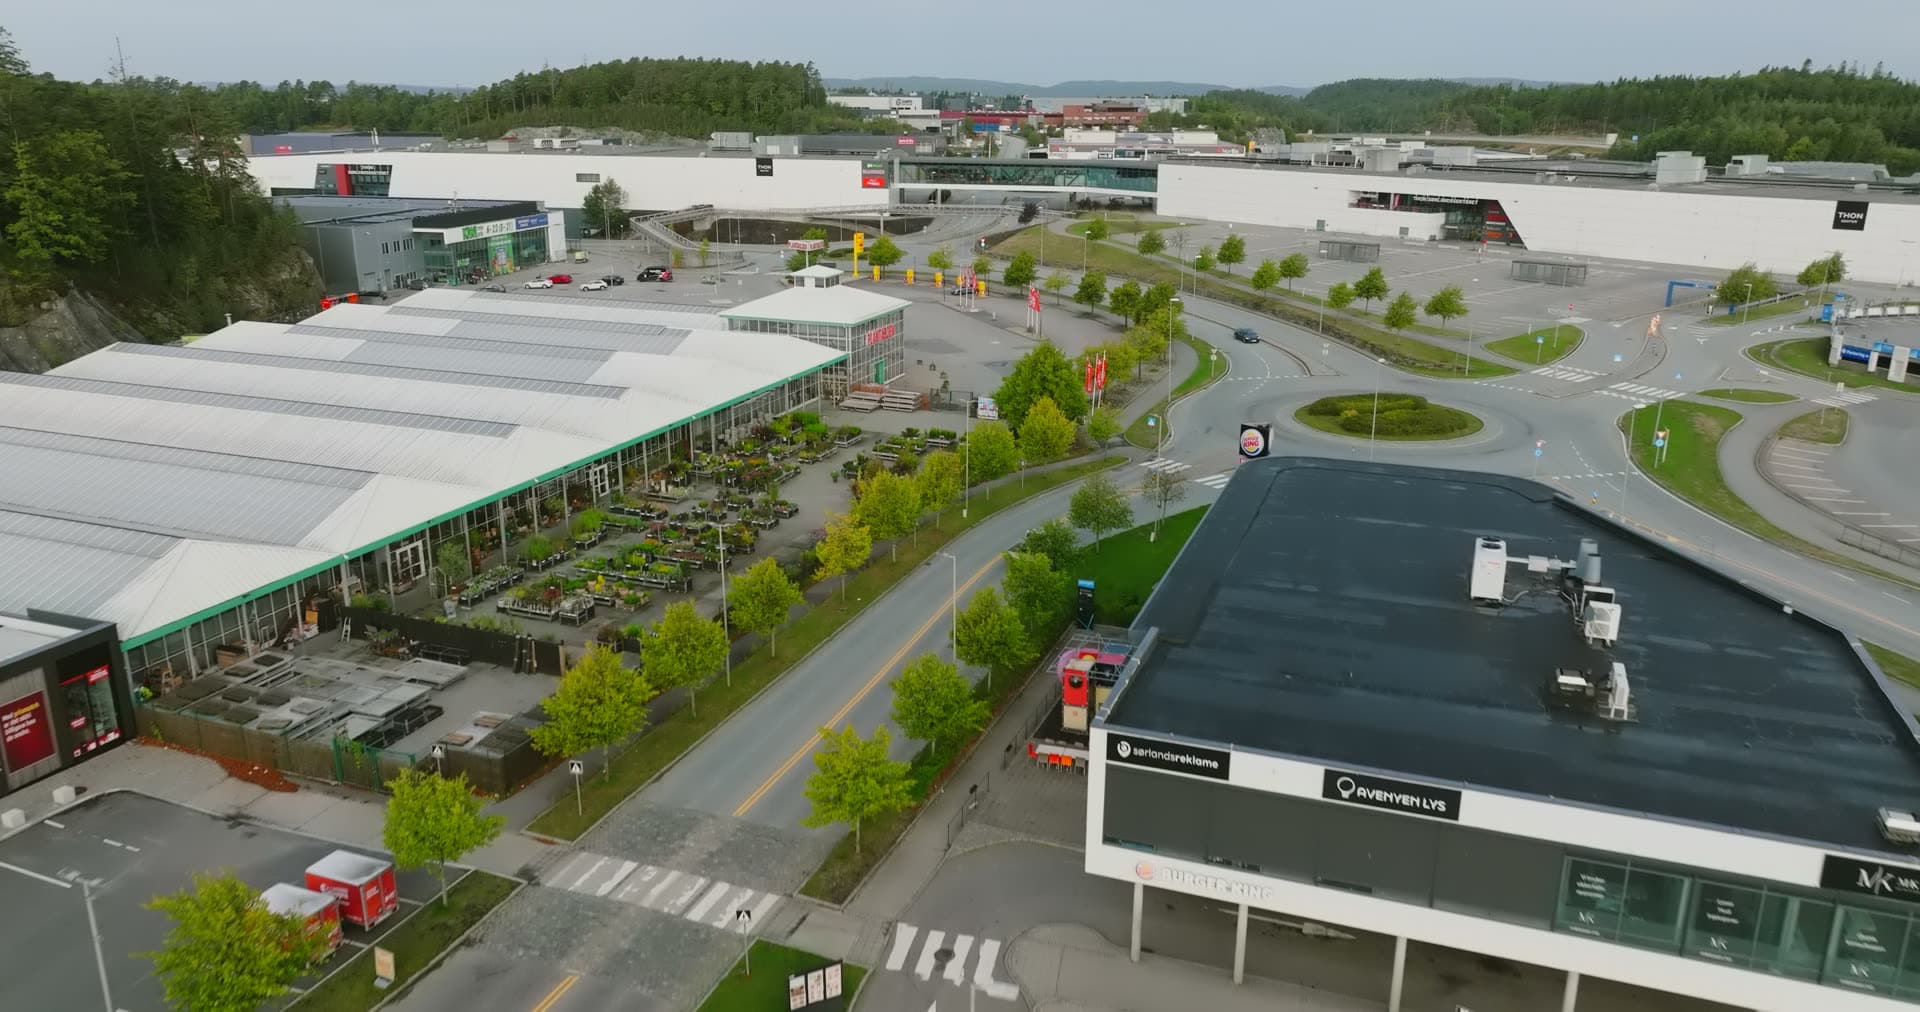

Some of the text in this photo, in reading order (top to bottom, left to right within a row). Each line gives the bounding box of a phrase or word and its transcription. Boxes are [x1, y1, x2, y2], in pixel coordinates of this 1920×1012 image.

[1837, 211, 1864, 220] THON
[1132, 747, 1219, 769] sørlandsreklame
[1357, 786, 1447, 812] AVENYEN LYS
[1161, 866, 1231, 892] BURGER
[1231, 879, 1273, 899] KING
[1856, 865, 1896, 895] MK
